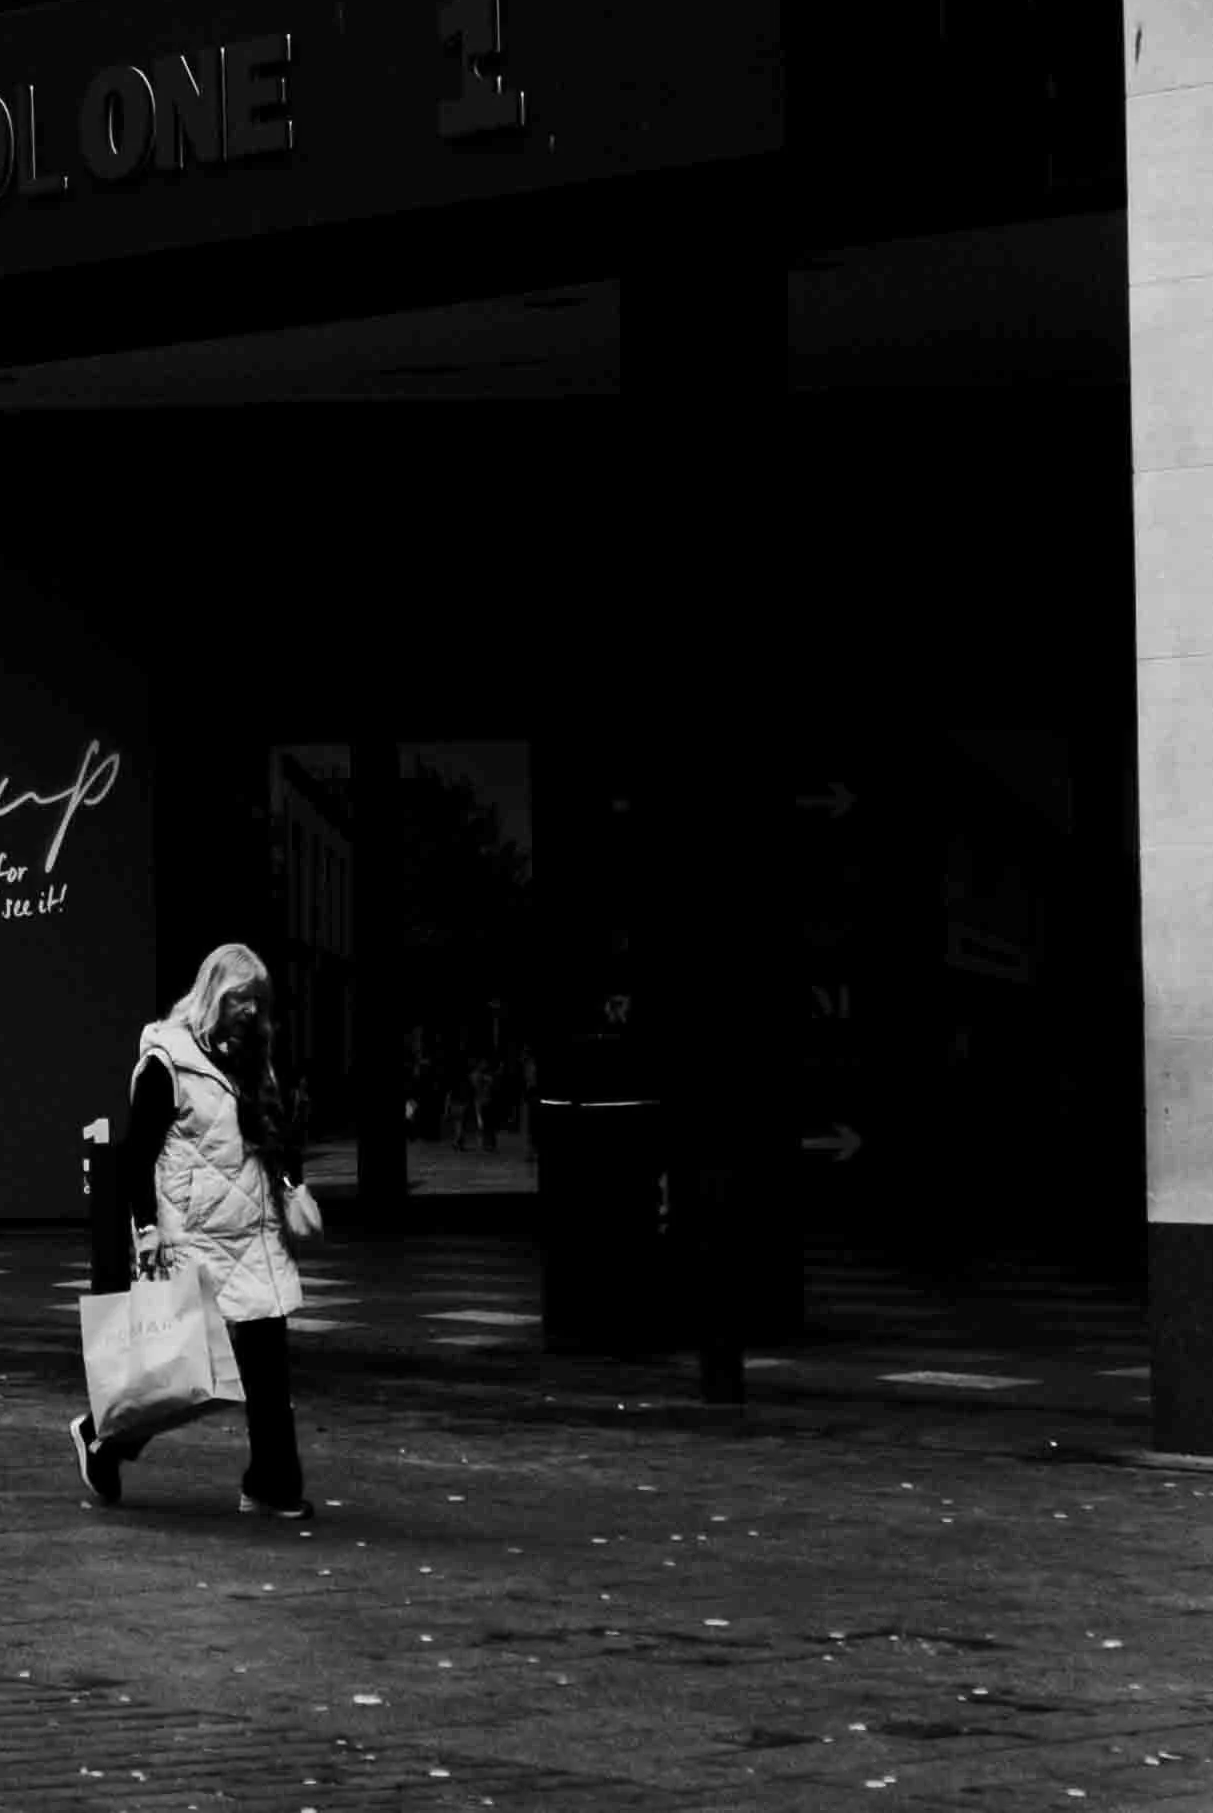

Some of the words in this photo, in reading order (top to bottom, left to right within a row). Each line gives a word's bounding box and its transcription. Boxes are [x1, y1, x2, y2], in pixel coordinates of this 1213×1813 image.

[79, 32, 295, 181] ONE
[1, 897, 32, 920] see
[36, 883, 69, 916] it!
